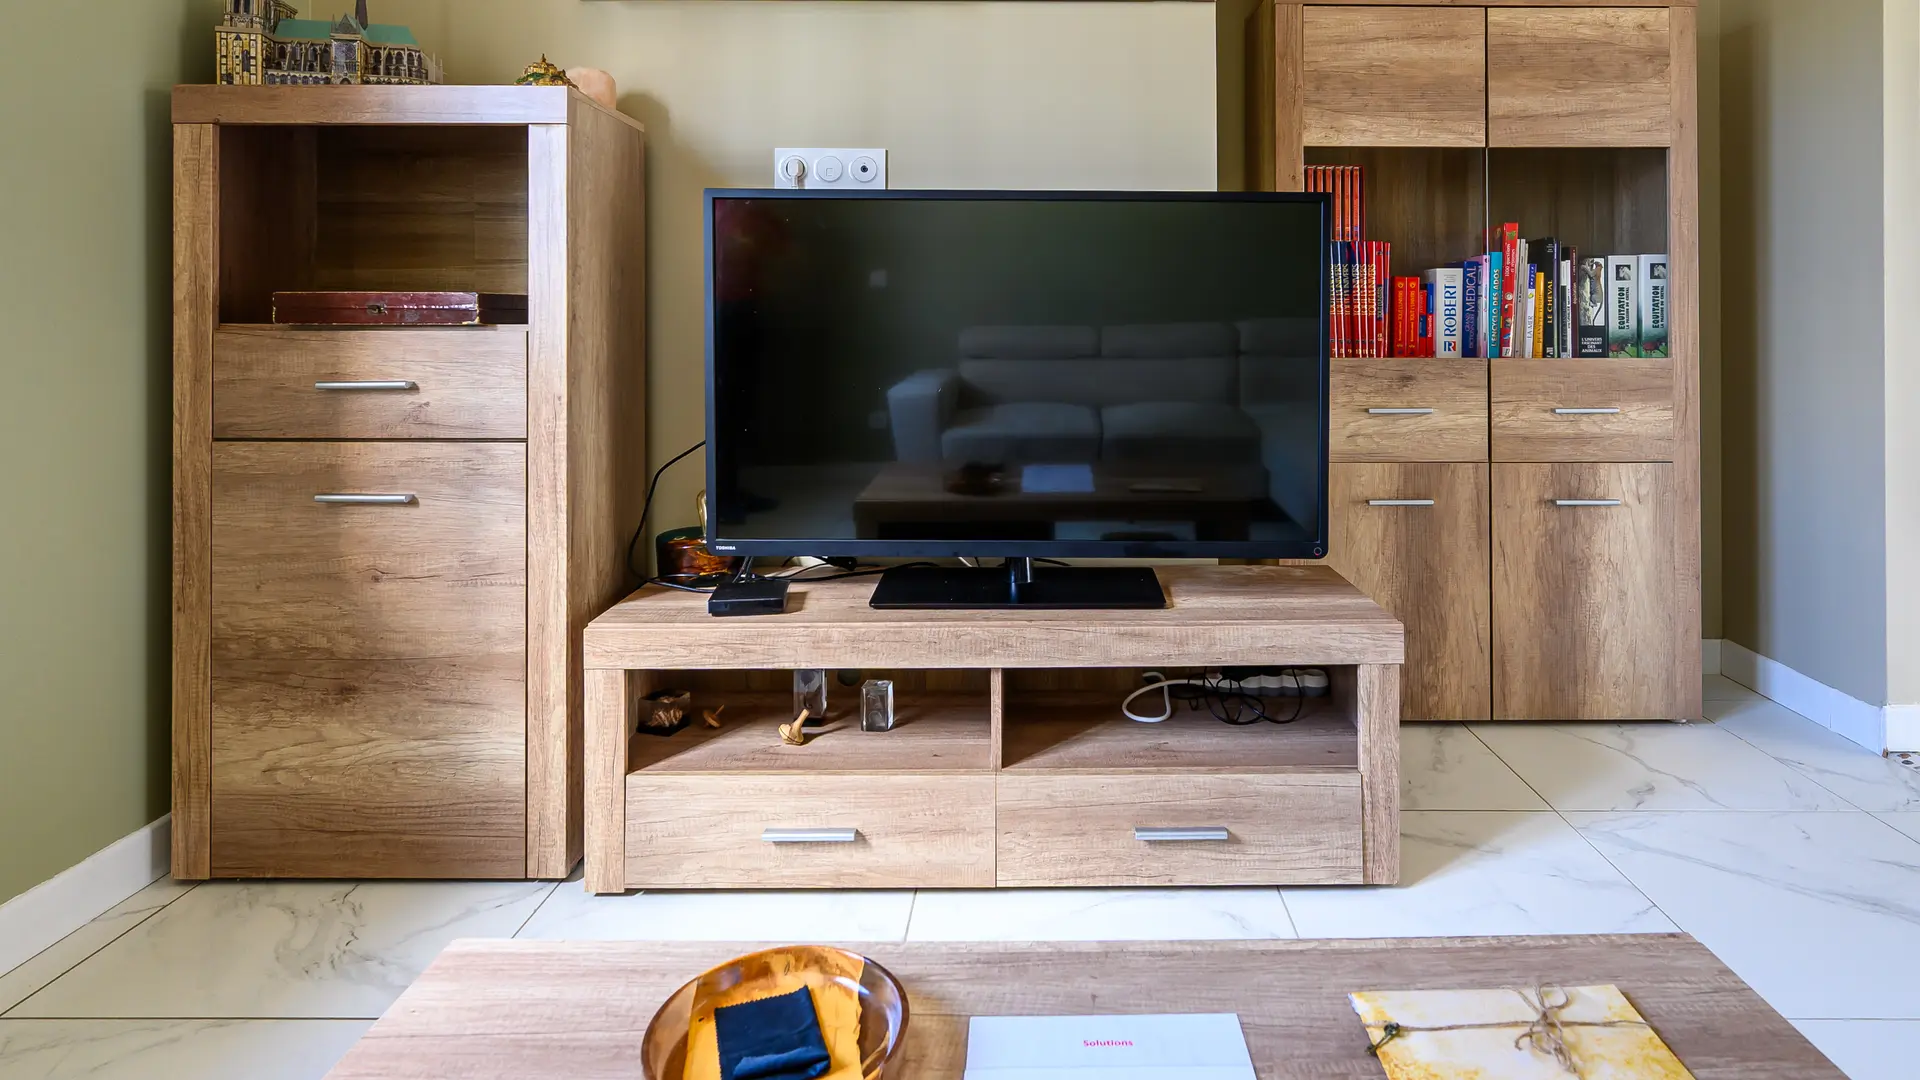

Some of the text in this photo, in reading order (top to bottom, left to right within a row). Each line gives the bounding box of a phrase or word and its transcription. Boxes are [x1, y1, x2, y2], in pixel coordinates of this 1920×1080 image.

[1368, 298, 1376, 316] TOUT
[1444, 284, 1457, 337] ROBERT
[1652, 285, 1660, 328] EQUITATION
[1083, 1039, 1134, 1047] Solutions
